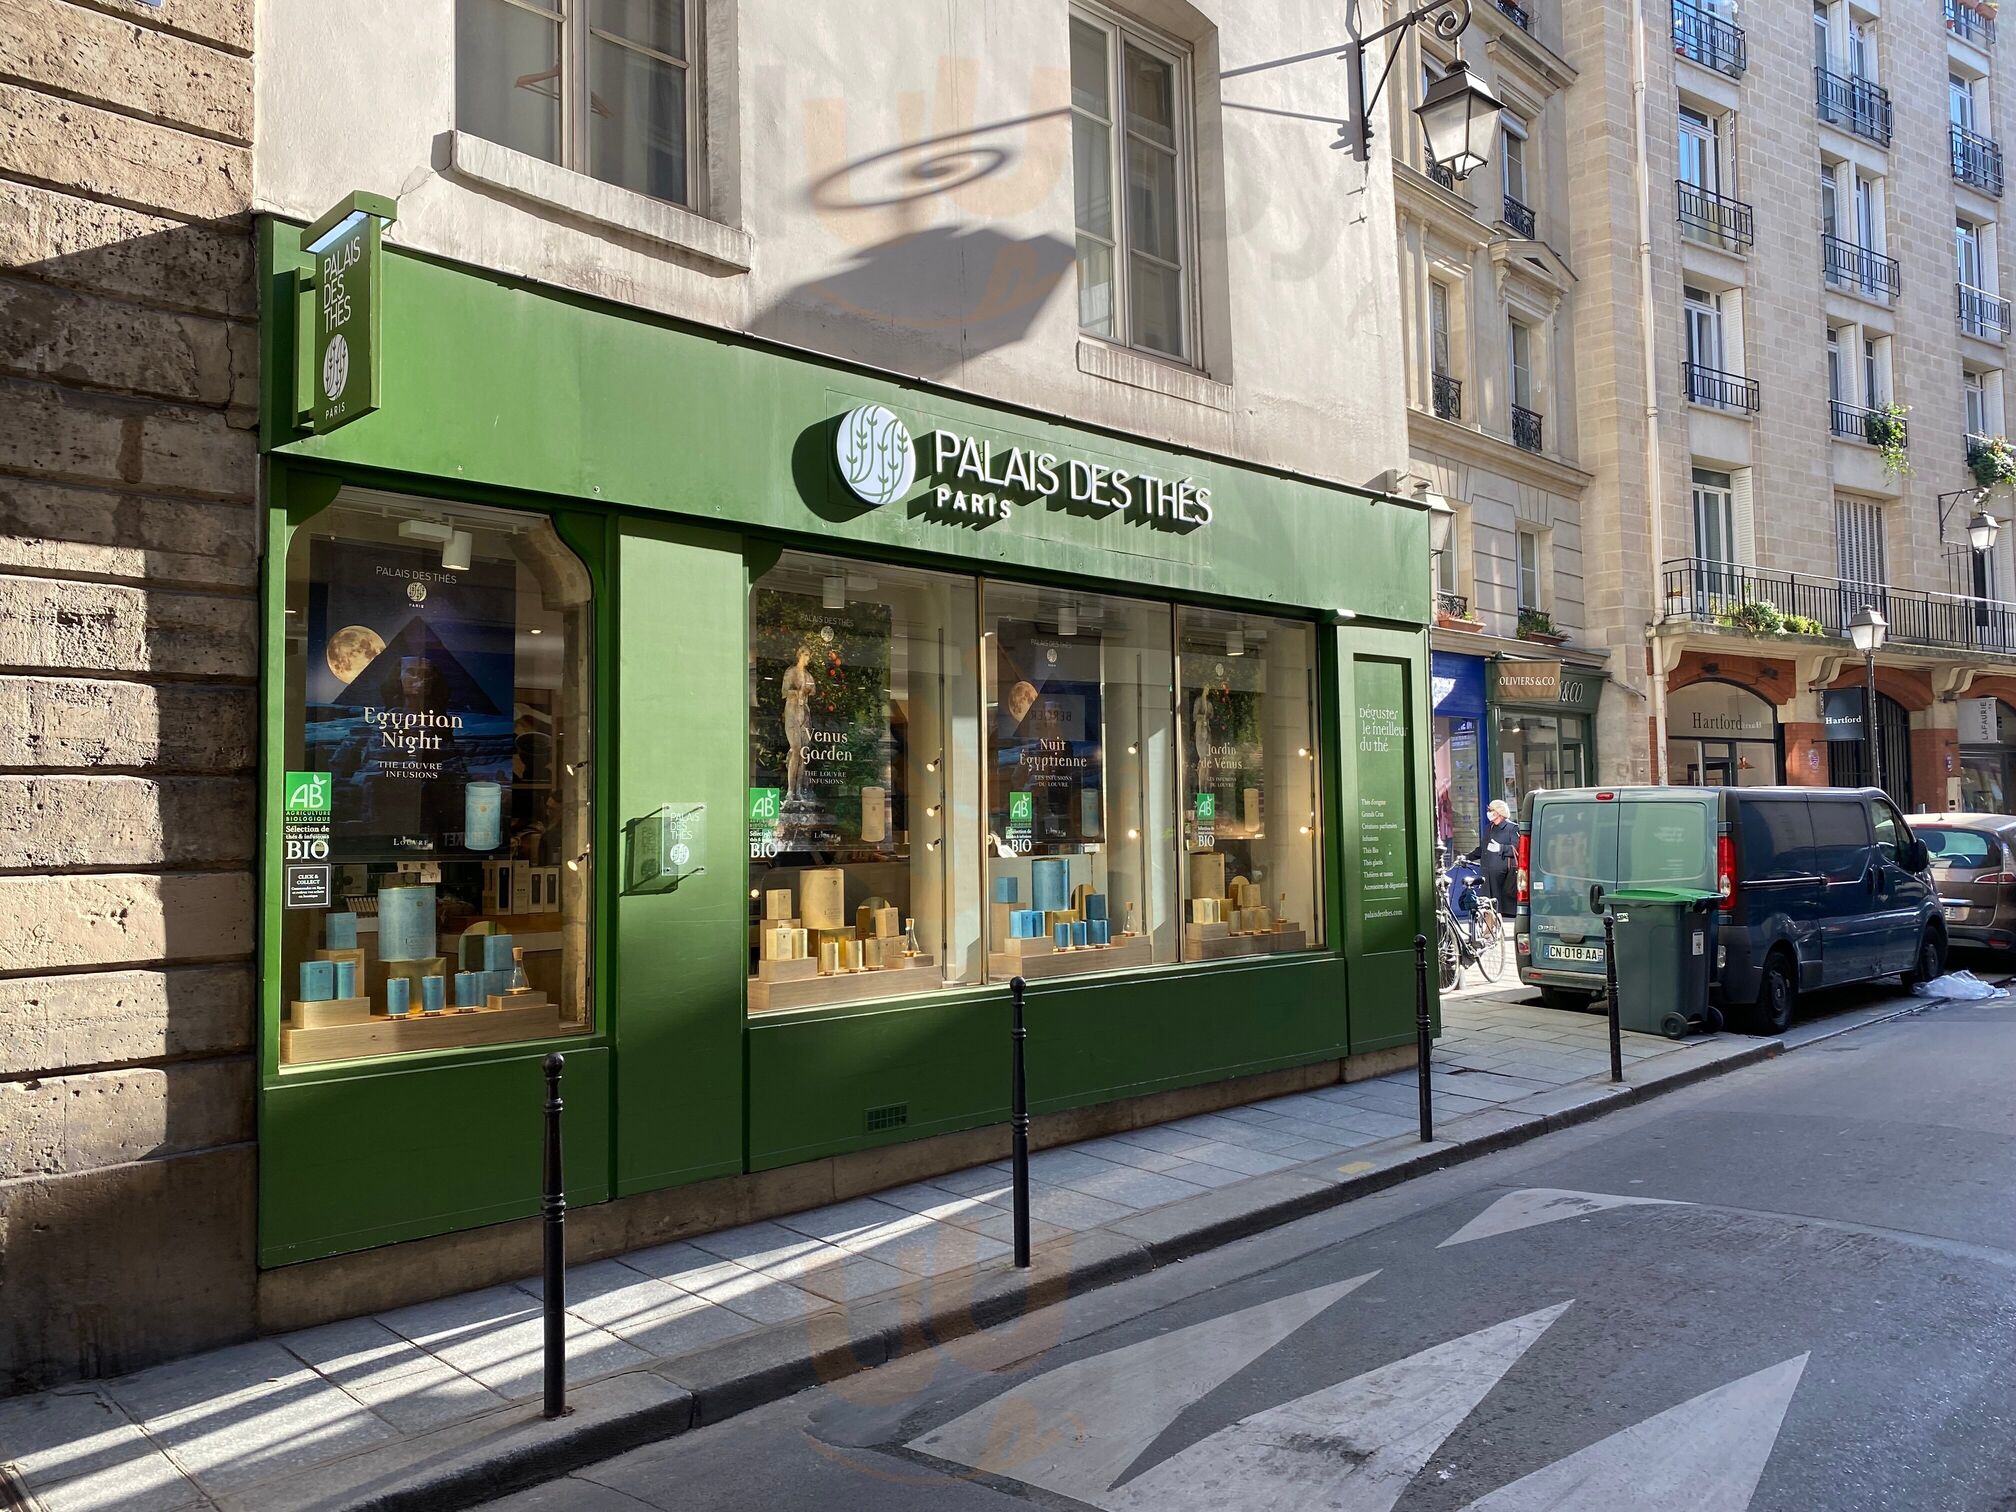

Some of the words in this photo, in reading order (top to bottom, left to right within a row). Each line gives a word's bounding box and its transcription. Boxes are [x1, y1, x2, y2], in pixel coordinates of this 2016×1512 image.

[324, 236, 361, 284] PALAIS
[324, 274, 345, 309] DES
[326, 402, 346, 420] PARIS
[935, 429, 1059, 495] PALAIS
[1069, 459, 1132, 510] DES
[1138, 474, 1213, 525] THÉS
[936, 487, 1012, 519] PARIS
[376, 566, 410, 579] PALAIS
[412, 571, 432, 581] DES
[824, 616, 837, 625] DES
[364, 706, 464, 730] Egyptian
[1359, 704, 1398, 725] Déguster
[1692, 711, 1743, 731] Hartford
[1825, 715, 1862, 725] Hartford
[1980, 701, 1989, 741] LAFAURIE
[805, 727, 848, 743] Venus
[1362, 720, 1370, 735] le
[1373, 720, 1408, 737] meilleur
[382, 730, 443, 754] Night
[1040, 736, 1066, 751] Nuit
[1207, 742, 1237, 756] Jardin
[1360, 741, 1371, 752] du
[1373, 736, 1389, 752] thé
[800, 746, 853, 764] Garden
[1019, 749, 1087, 772] Égyptienne
[1201, 758, 1212, 769] de
[1214, 757, 1243, 769] Vénus
[378, 761, 398, 769] THE
[402, 761, 443, 770] LOUVRE
[386, 770, 438, 779] INFUSIONS
[290, 783, 324, 808] AB
[752, 798, 775, 817] AB
[1012, 800, 1028, 818] AB
[1199, 801, 1212, 816] AB
[286, 825, 319, 833] Sélection
[320, 825, 330, 833] de
[670, 821, 687, 831] DES
[1011, 839, 1032, 853] BIO
[1198, 835, 1214, 847] BIO
[286, 840, 330, 860] BIO
[750, 843, 777, 858] BIO
